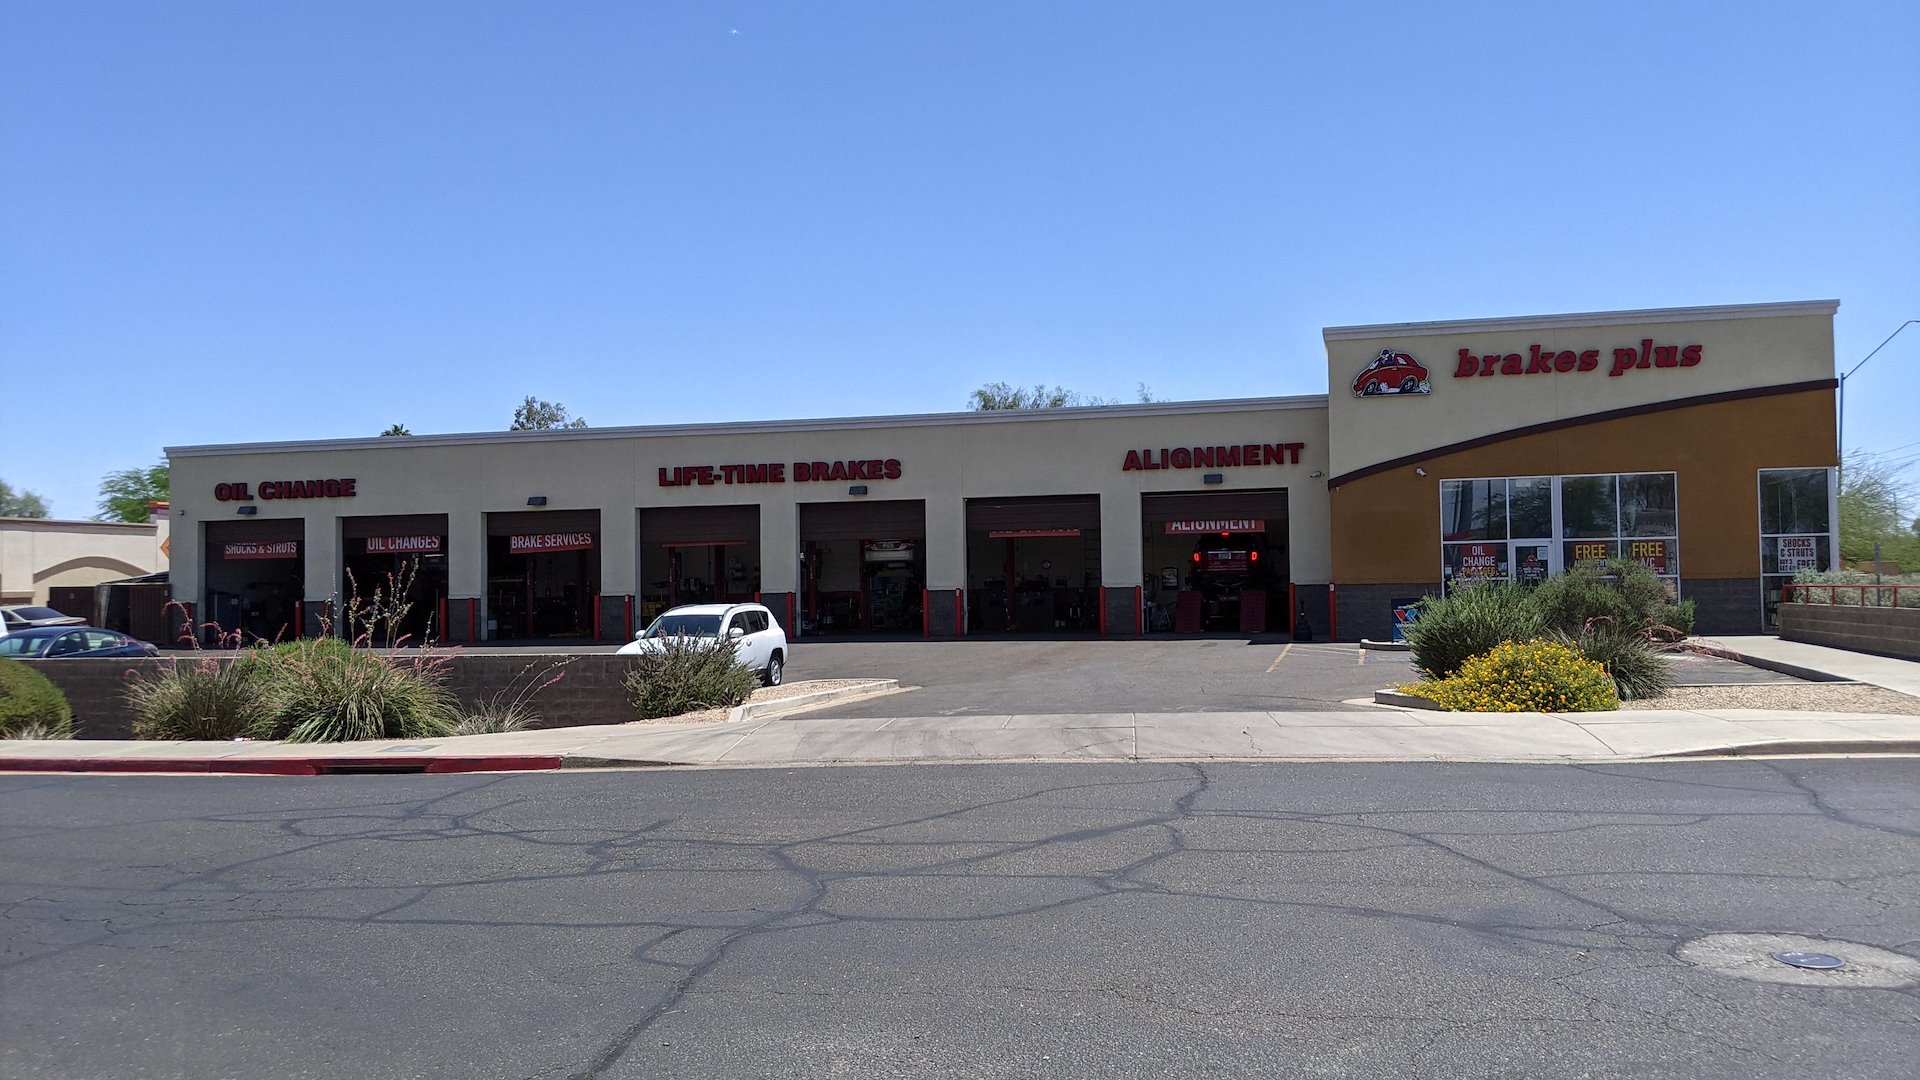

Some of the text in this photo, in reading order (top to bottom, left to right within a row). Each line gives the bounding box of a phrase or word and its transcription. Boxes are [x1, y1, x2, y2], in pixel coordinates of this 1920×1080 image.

[1453, 339, 1703, 378] brakes plus
[1122, 442, 1305, 471] ALIGNMENT
[658, 458, 902, 487] LIFE-TIME BRAKES
[214, 478, 357, 501] OIL CHANGE
[1171, 520, 1256, 531] ALIGNMENT
[225, 542, 297, 554] SHOCKS & STRUTS
[367, 535, 440, 550] OIL CHANGES
[511, 532, 592, 549] BRAKE SERVICES
[1782, 538, 1811, 548] SHOCKS
[1471, 545, 1486, 556] OIL
[1575, 544, 1606, 559] FREE
[1632, 542, 1663, 557] FREE
[1780, 548, 1814, 558] & STRUTS
[1462, 556, 1496, 567] CHANGE
